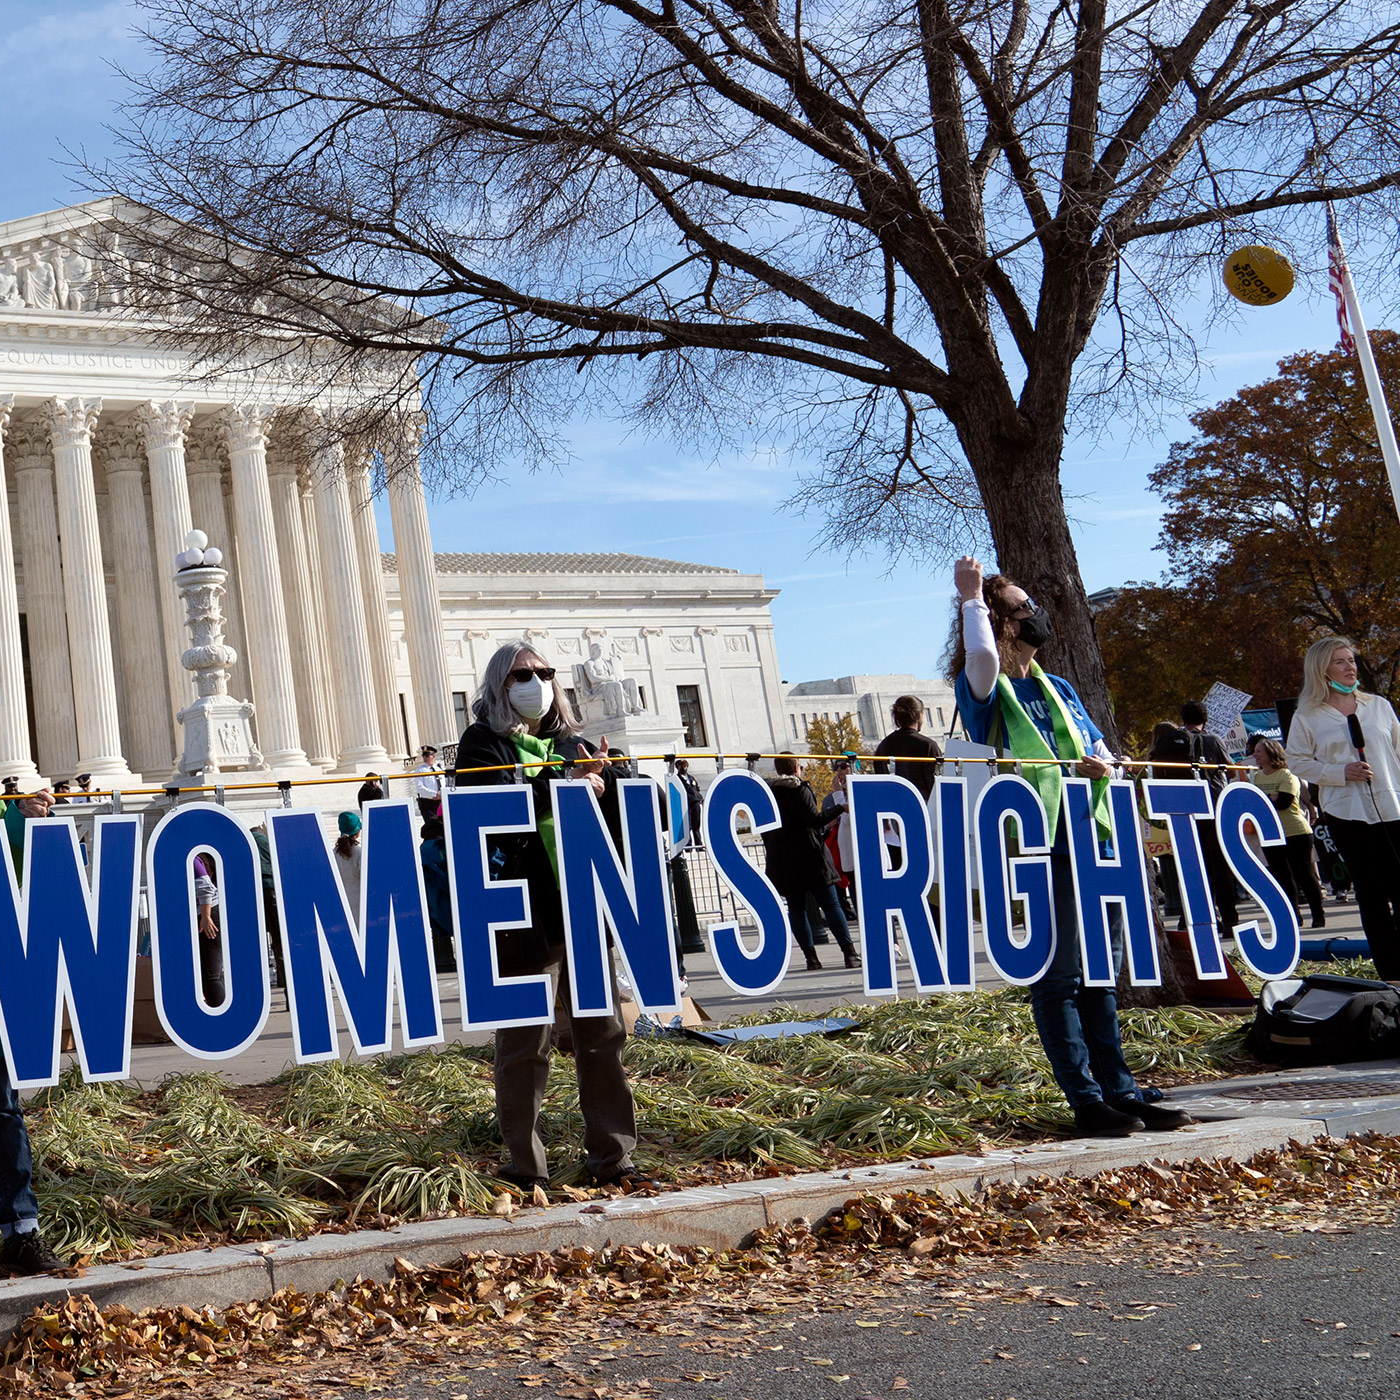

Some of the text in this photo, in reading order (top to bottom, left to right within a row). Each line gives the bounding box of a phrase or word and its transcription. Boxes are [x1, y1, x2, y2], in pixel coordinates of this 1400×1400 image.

[1233, 263, 1270, 303] OFF OUR
[1242, 263, 1277, 299] BODIES
[63, 352, 133, 369] JUSTICE
[141, 356, 194, 371] UNDE
[1214, 682, 1250, 702] TEXAS SIZE
[1224, 737, 1247, 751] PINION
[847, 773, 1300, 996] RIGHTS
